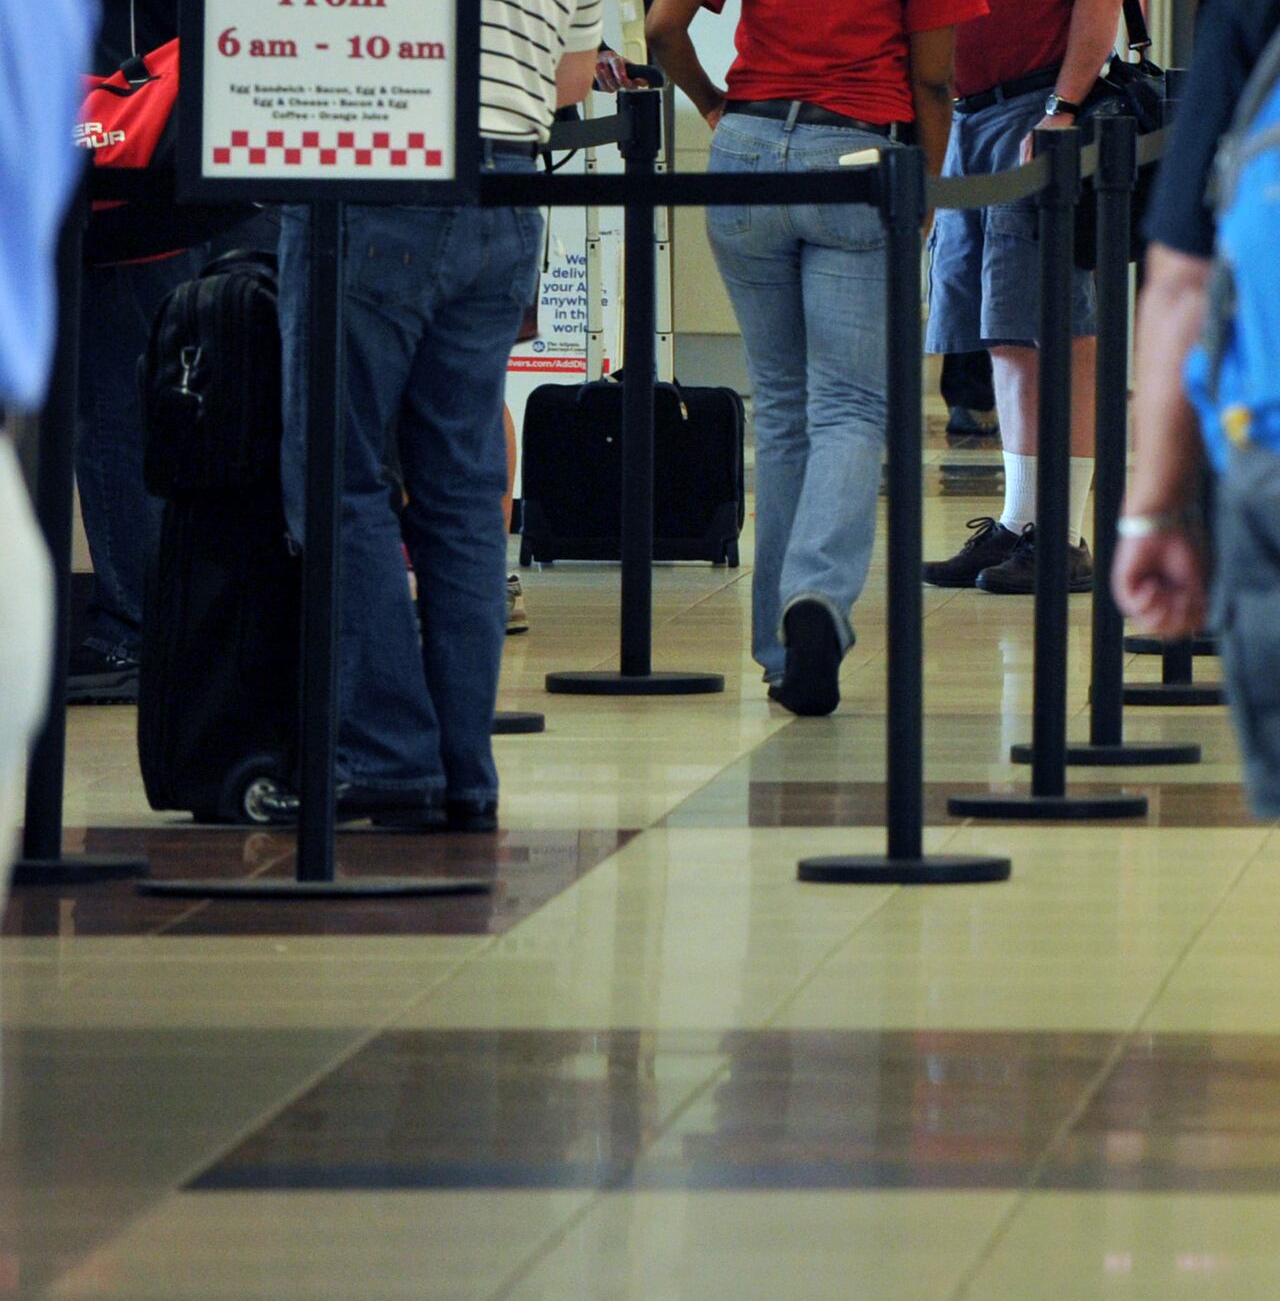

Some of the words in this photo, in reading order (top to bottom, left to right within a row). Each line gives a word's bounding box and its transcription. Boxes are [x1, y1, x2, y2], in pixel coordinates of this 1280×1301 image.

[217, 26, 241, 58] 6
[249, 39, 298, 58] am
[347, 34, 390, 59] 10
[397, 40, 446, 60] am
[552, 268, 586, 279] deliv
[543, 281, 573, 294] your
[541, 296, 608, 308] anywhe
[555, 309, 567, 320] in
[570, 309, 587, 320] th
